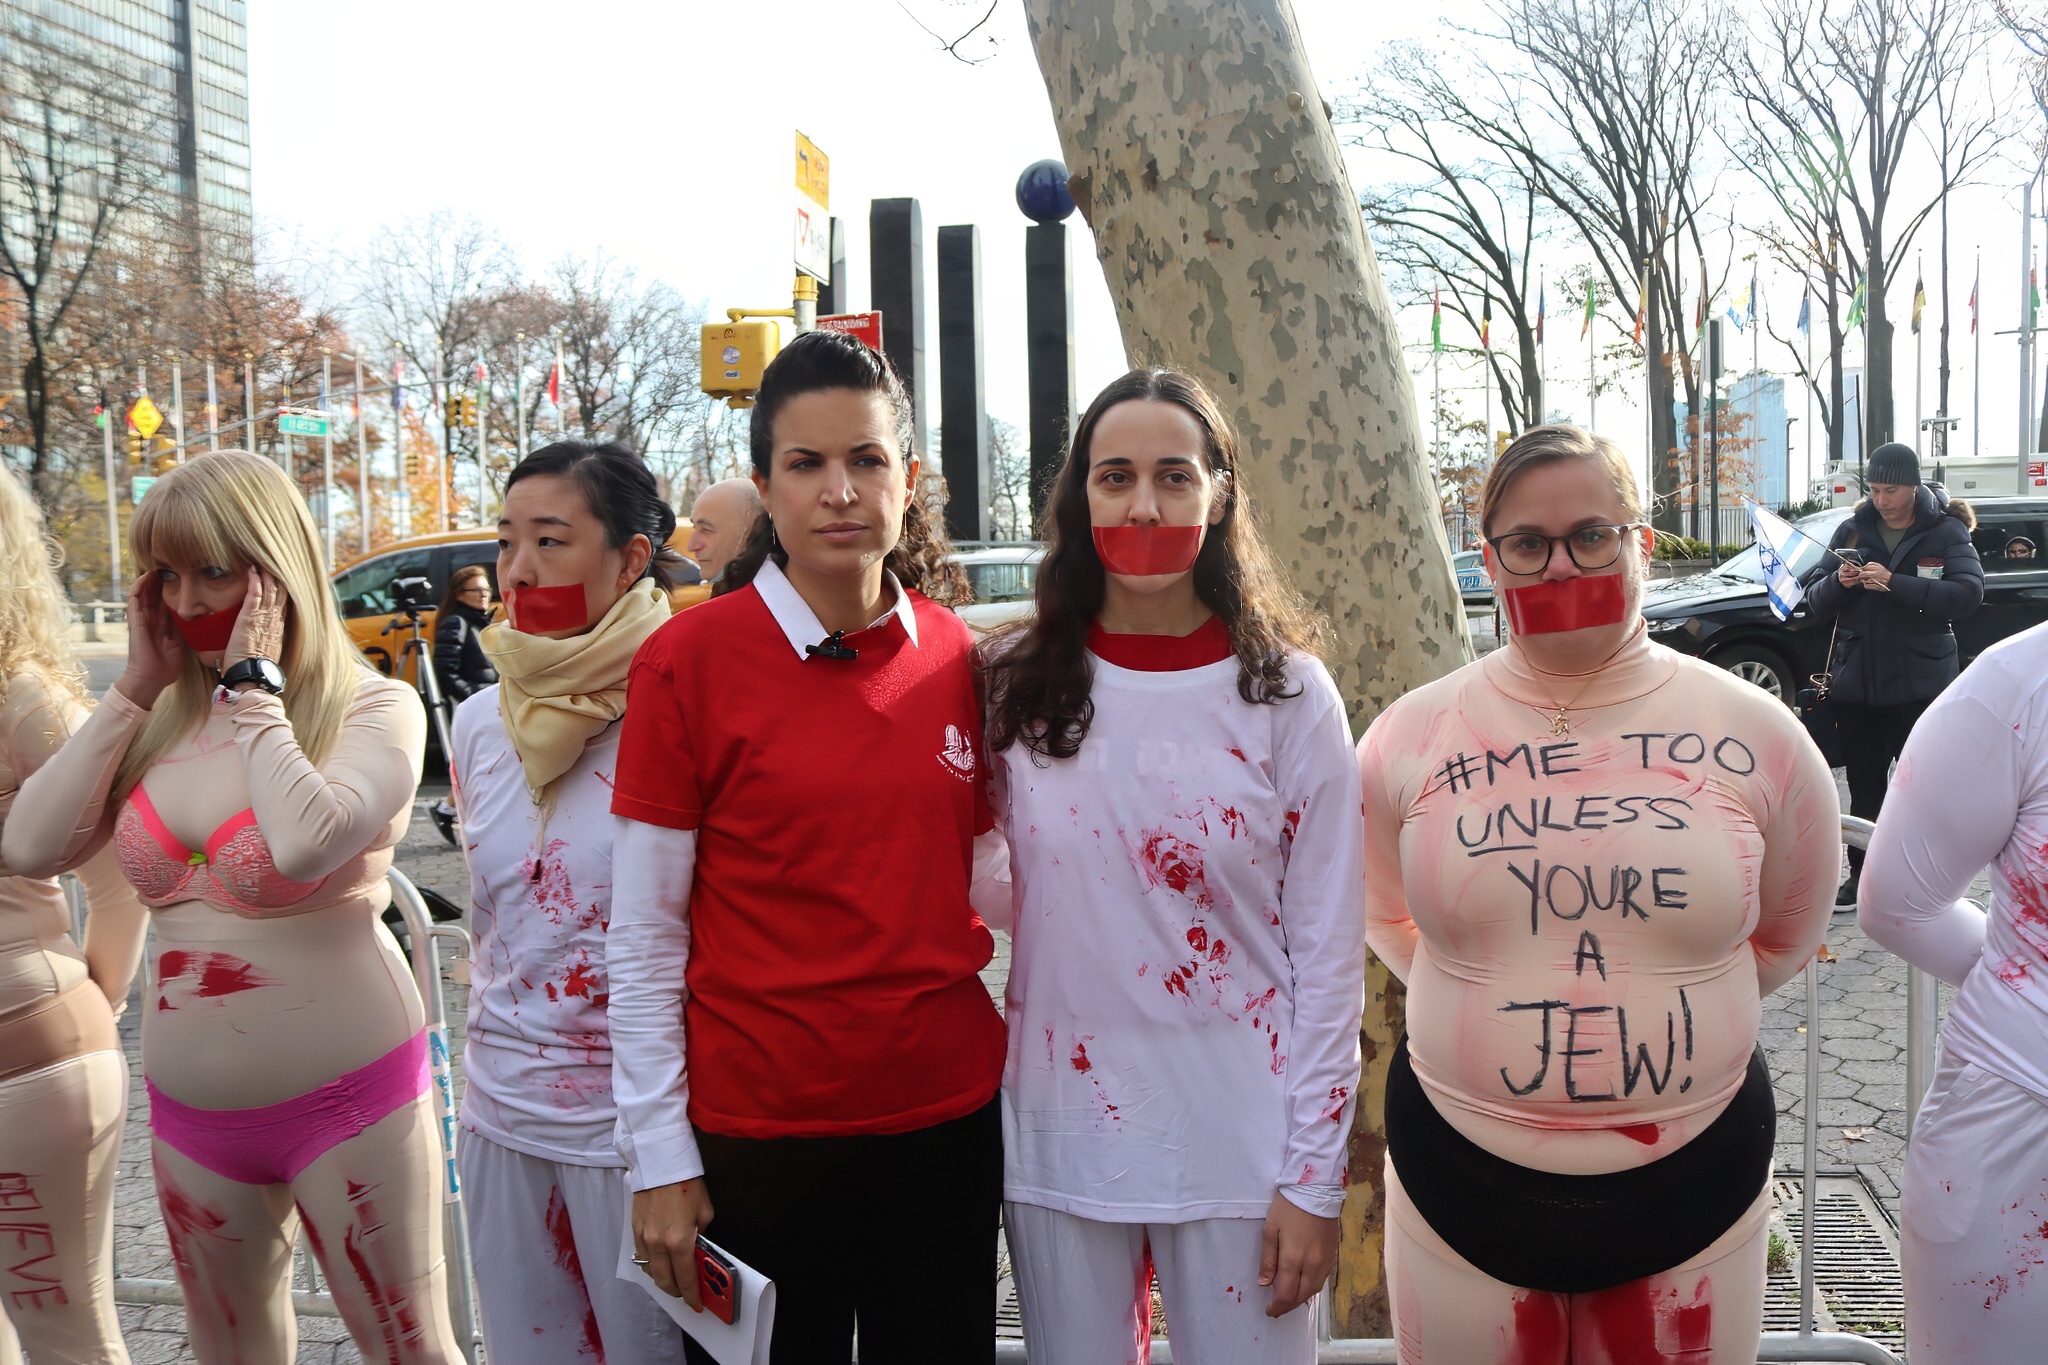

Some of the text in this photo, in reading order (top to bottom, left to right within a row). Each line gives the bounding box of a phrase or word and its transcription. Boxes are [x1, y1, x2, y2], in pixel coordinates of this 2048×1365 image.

[1434, 732, 1756, 794] #ME TOO
[1456, 795, 1693, 852] UNLESS
[1507, 858, 1688, 936] YOURE
[1573, 929, 1607, 982] A
[1496, 986, 1694, 1103] JEW!
